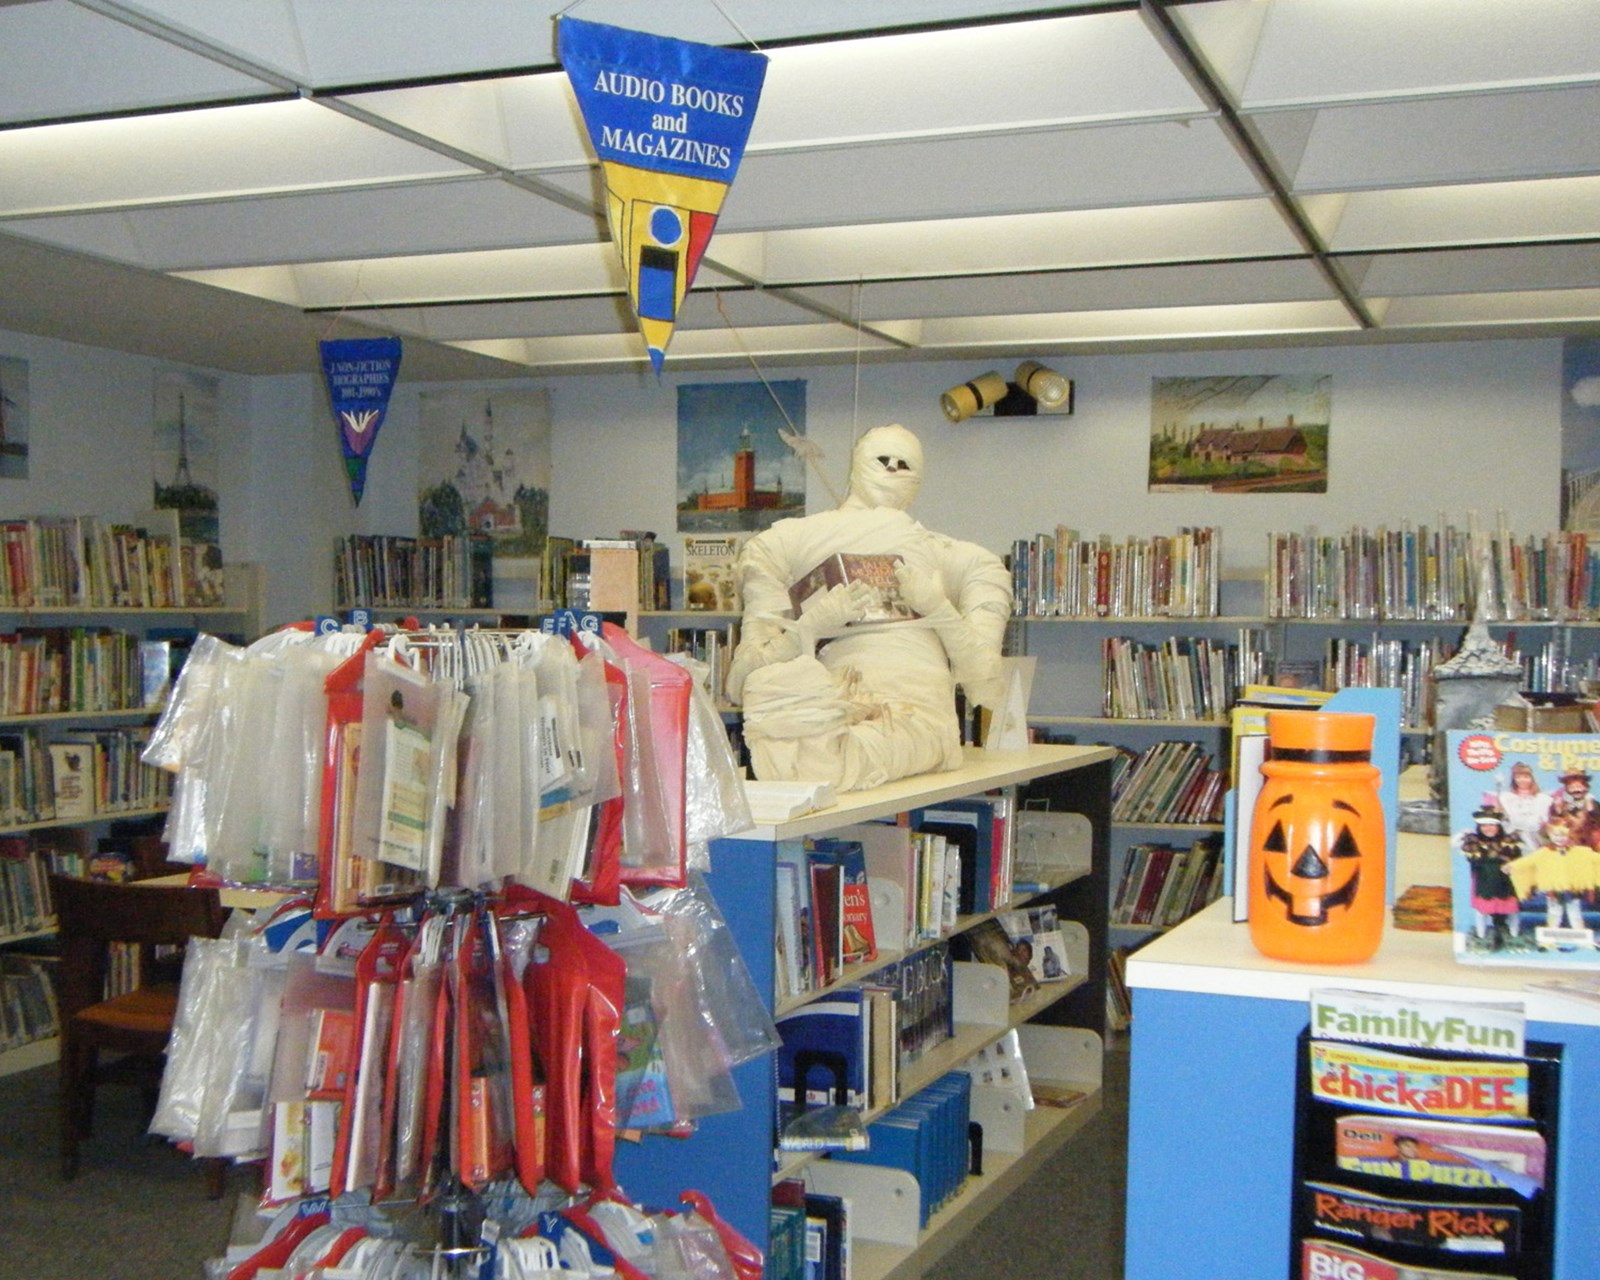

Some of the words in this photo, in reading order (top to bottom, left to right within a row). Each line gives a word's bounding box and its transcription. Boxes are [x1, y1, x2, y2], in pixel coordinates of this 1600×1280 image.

[594, 70, 664, 103] AUDIO
[671, 83, 744, 118] BOOKS
[652, 112, 687, 134] and
[601, 126, 731, 169] MAGAZINES
[333, 373, 390, 386] BIOGRAPHIES
[686, 545, 736, 556] SKELETON
[353, 610, 368, 625] B
[543, 618, 554, 633] E
[581, 615, 598, 632] G
[321, 618, 338, 635] C
[1317, 1003, 1515, 1048] FamilyFun
[1320, 1064, 1515, 1113] chickaDEE
[1344, 1129, 1382, 1142] Dell
[1315, 1191, 1423, 1230] Ranger
[1428, 1209, 1496, 1238] Rick
[544, 1215, 558, 1233] Y
